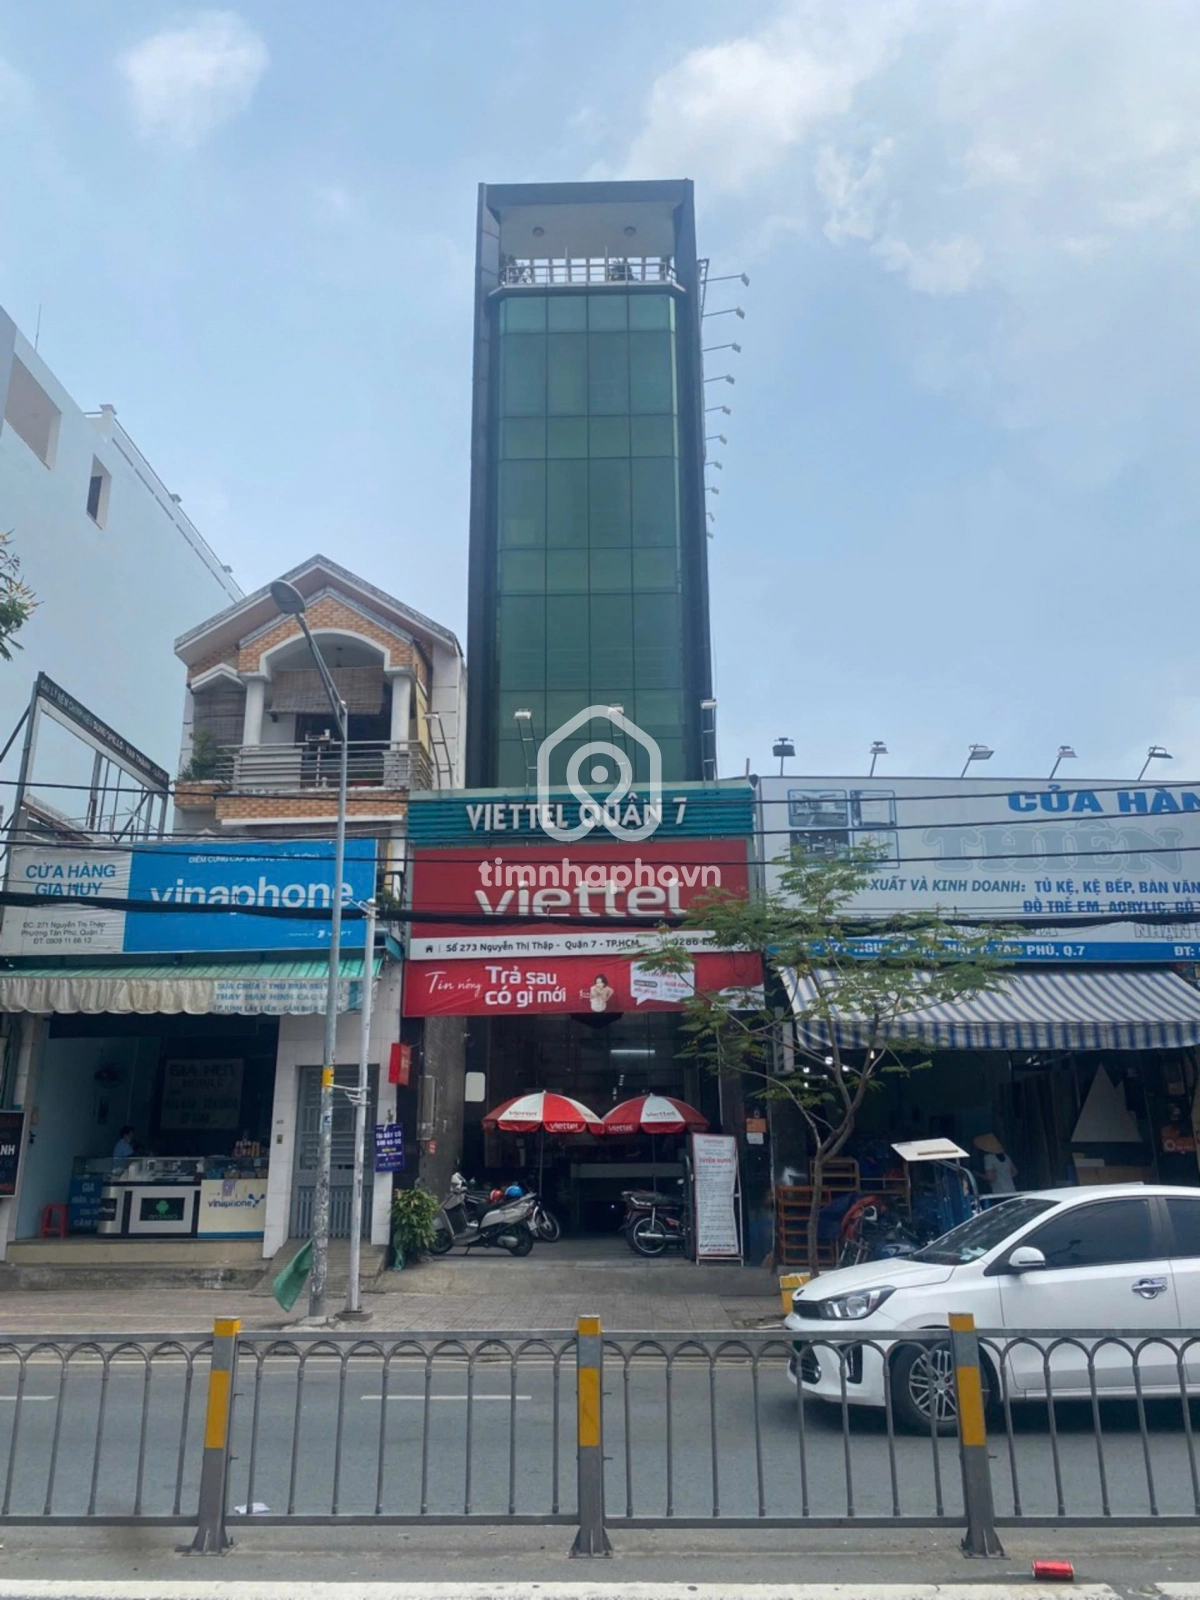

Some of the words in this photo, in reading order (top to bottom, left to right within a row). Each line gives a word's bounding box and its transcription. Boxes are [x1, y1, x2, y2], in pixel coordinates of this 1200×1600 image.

[1008, 785, 1103, 813] CỬA
[466, 803, 568, 831] VIETTEL
[579, 792, 663, 832] QUẬN
[673, 797, 687, 824] 7
[923, 819, 1184, 874] THIÊN
[26, 861, 64, 879] CỬA
[68, 861, 116, 878] HÀNG
[35, 882, 64, 896] GIA
[68, 882, 103, 896] HUY
[870, 876, 906, 891] XUẤT
[910, 876, 928, 891] VÀ
[932, 880, 967, 892] KINH
[971, 880, 1026, 892] DOANH:
[1034, 877, 1051, 893] TỦ
[1056, 878, 1079, 895] KỆ,
[1083, 878, 1101, 895] KỆ
[1105, 877, 1135, 894] BẾP,
[1139, 879, 1168, 893] BÀN
[475, 878, 690, 918] viettel
[1023, 896, 1042, 914] ĐỒ
[1046, 895, 1072, 914] TRẺ
[446, 942, 458, 952] Số
[460, 943, 477, 952] 273
[480, 940, 513, 953] Nguyễn
[516, 941, 529, 951] Thị
[532, 941, 554, 951] Thập
[565, 940, 588, 950] Quận
[591, 940, 597, 949] 7
[1027, 942, 1059, 957] PHÚ,
[1063, 944, 1085, 957] Q.7
[1174, 945, 1195, 957] ĐT:
[425, 971, 454, 994] Tin
[457, 979, 482, 997] nóng
[485, 966, 521, 985] Trả
[526, 972, 557, 985] sau
[485, 986, 511, 1005] có
[516, 986, 533, 1007] gì
[537, 987, 566, 1003] mới
[549, 1121, 579, 1130] viettel
[208, 1199, 252, 1208] vinaphone
